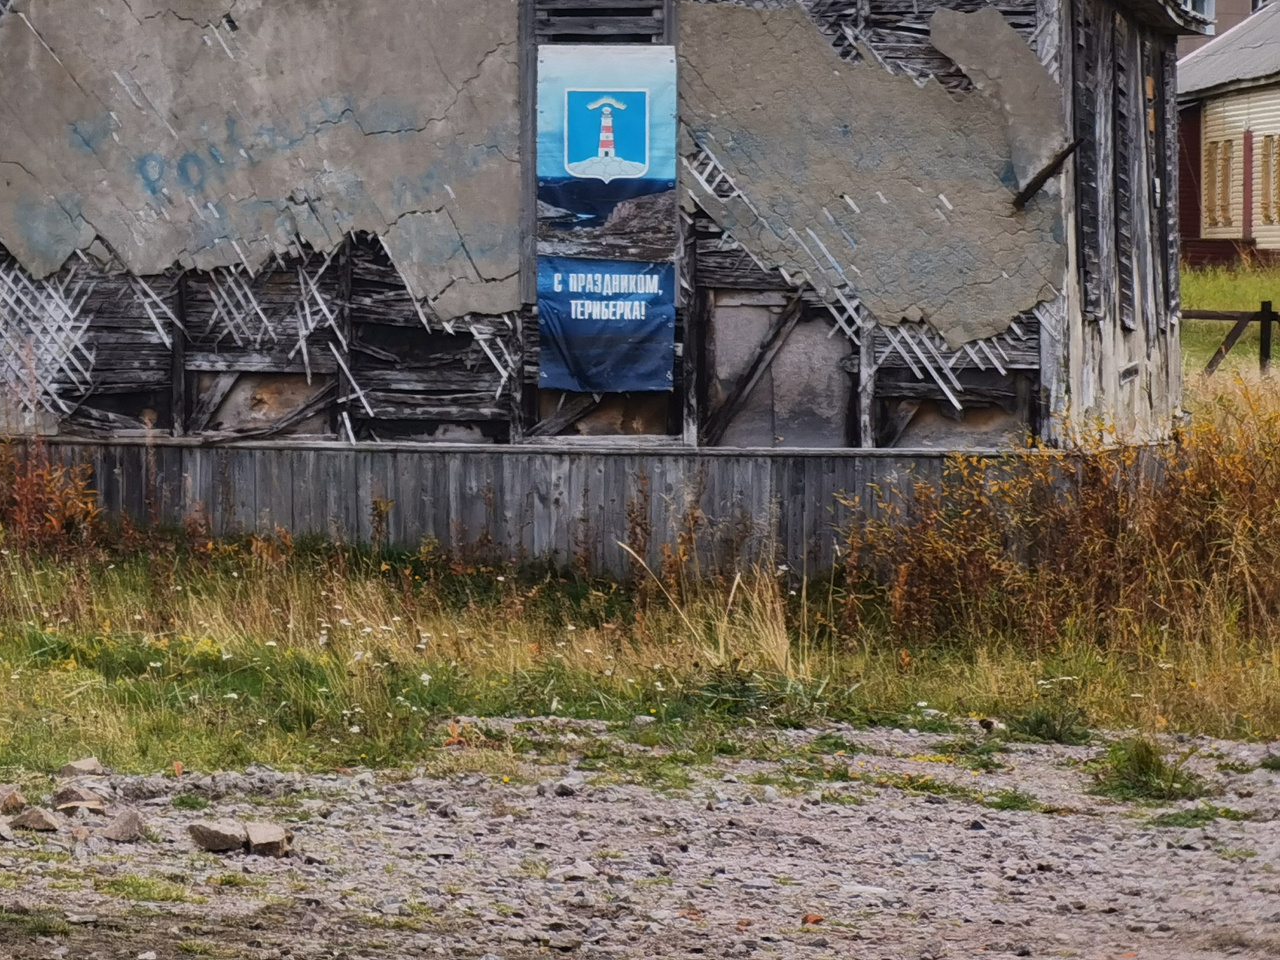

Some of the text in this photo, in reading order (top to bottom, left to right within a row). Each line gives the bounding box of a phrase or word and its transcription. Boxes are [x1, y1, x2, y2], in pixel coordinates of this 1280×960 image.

[553, 273, 663, 296] С ПРАЗДНИКОМ,
[570, 300, 646, 320] ТЕРИБЕРКА!
